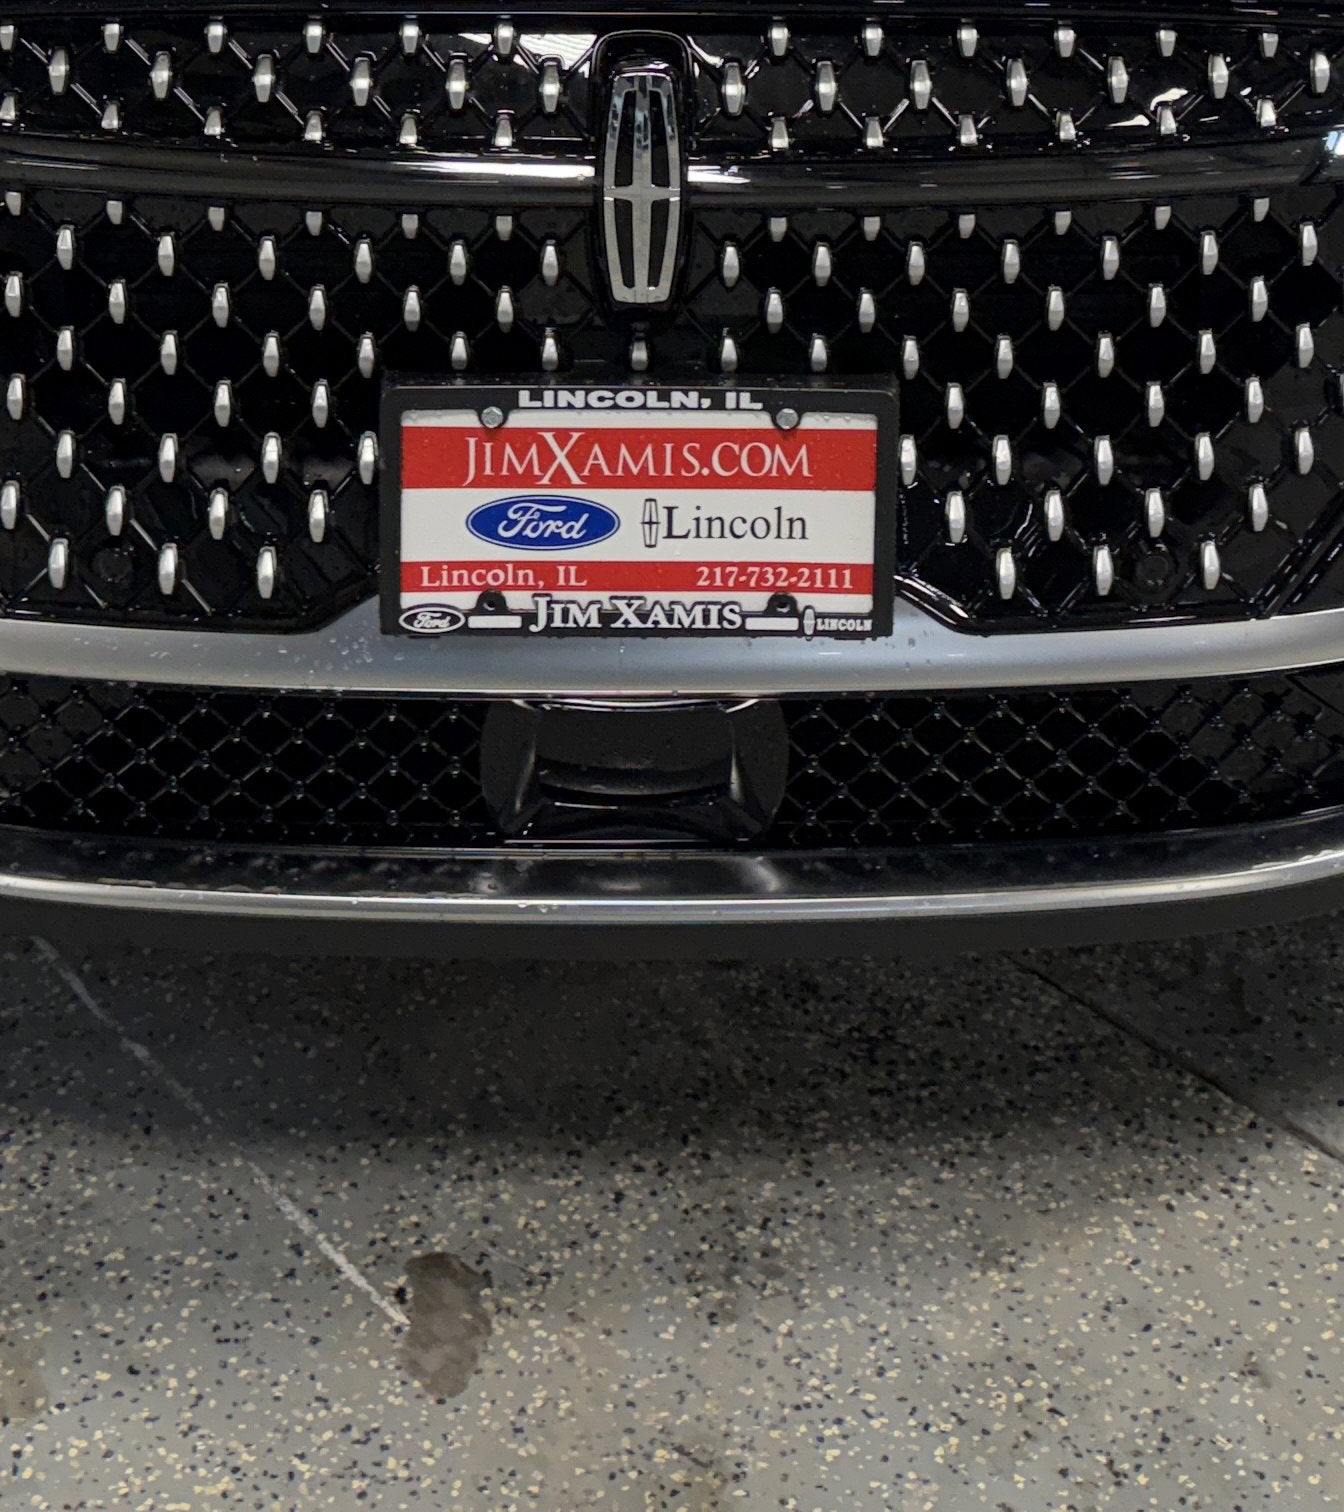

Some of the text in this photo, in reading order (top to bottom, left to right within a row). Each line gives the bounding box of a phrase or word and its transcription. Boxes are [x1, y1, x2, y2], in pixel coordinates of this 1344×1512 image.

[518, 389, 763, 410] LINCOLN, IL
[463, 431, 813, 486] JIMXAMIS.COM
[496, 499, 587, 541] Ford
[662, 506, 808, 539] Lincoln
[420, 563, 587, 590] Lincoln, IL
[696, 566, 853, 590] 217-732-2111
[412, 611, 452, 630] Ford
[529, 595, 743, 634] JIM XAMIS
[815, 617, 873, 633] LINCOLN
